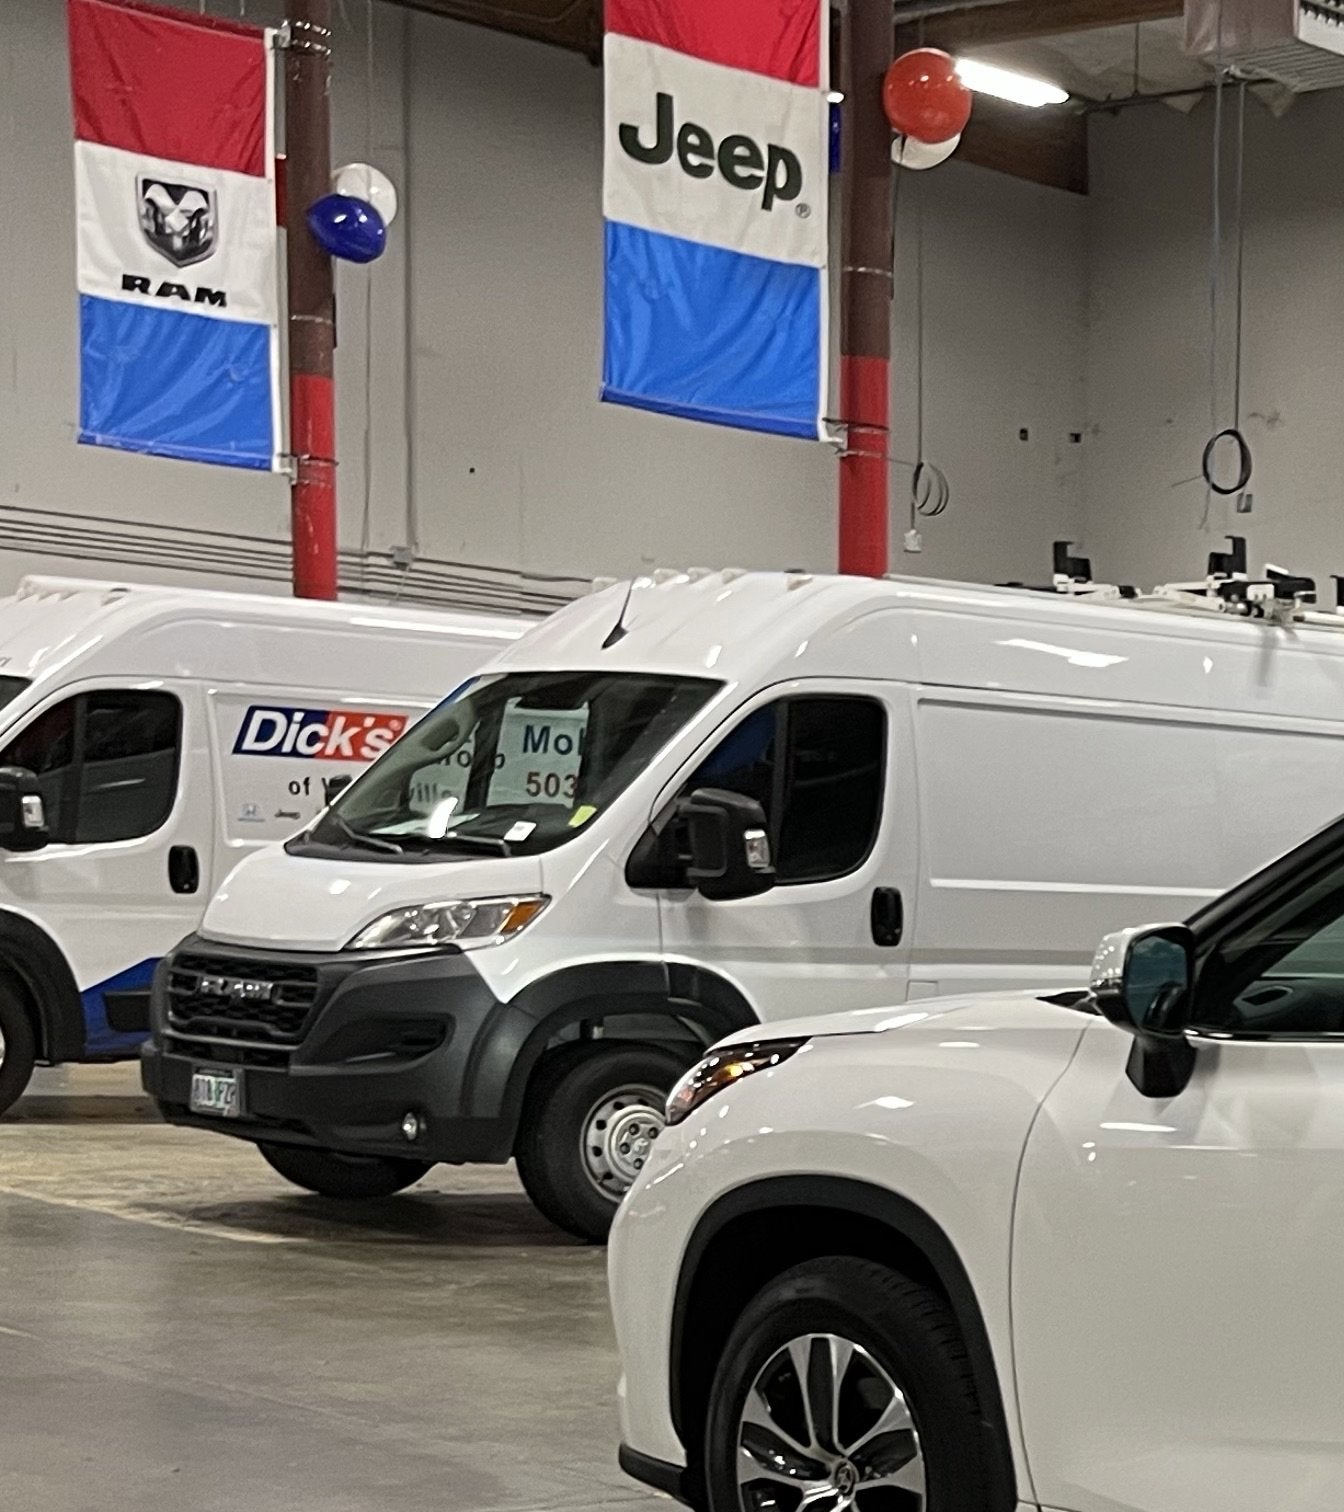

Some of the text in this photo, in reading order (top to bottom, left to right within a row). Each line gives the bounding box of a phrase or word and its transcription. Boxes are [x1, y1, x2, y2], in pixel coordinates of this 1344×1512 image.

[619, 92, 803, 212] Jeep
[122, 274, 227, 308] RAM
[288, 776, 311, 796] of
